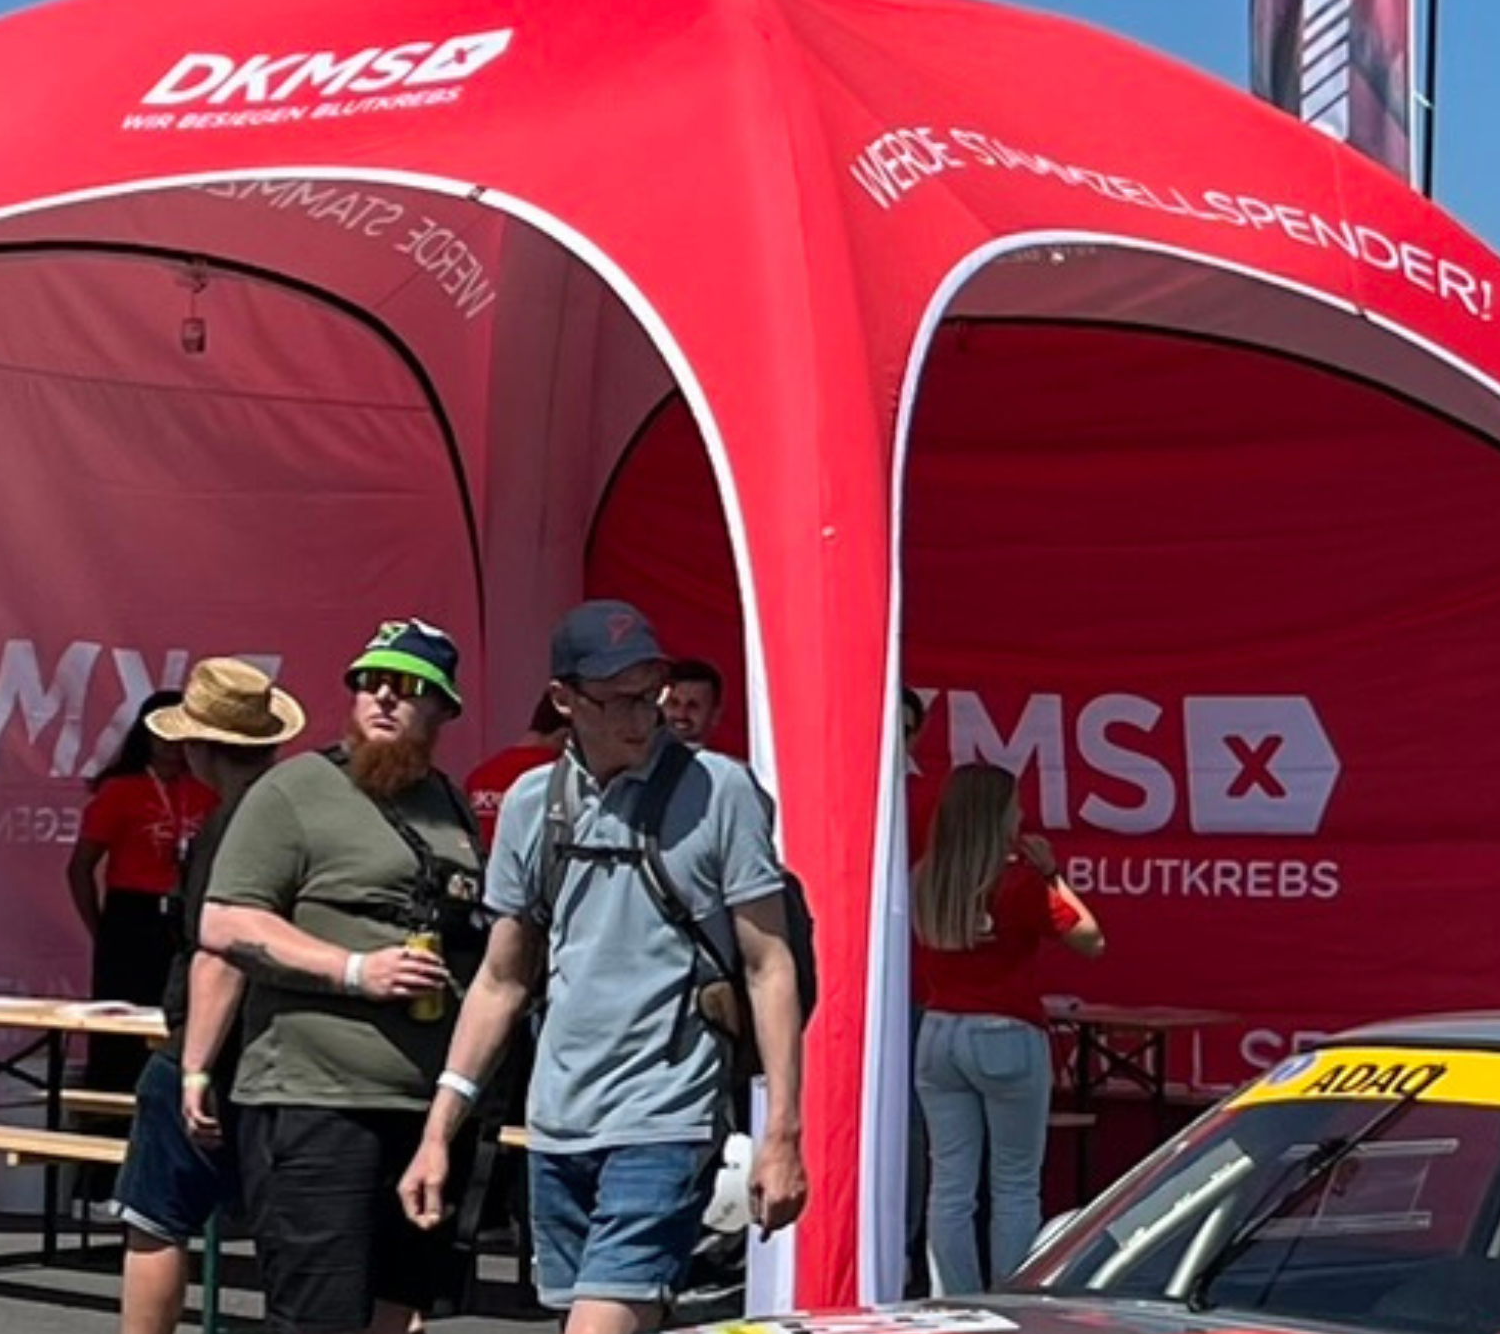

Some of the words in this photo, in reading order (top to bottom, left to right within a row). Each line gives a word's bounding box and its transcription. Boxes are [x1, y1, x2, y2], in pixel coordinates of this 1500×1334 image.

[140, 41, 413, 106] DKMS
[120, 111, 171, 131] WIR
[175, 104, 307, 130] BESIEGEN
[309, 85, 464, 121] BLUTKREBS
[849, 127, 966, 210] WERDE
[1067, 856, 1339, 899] BLUTKREBS
